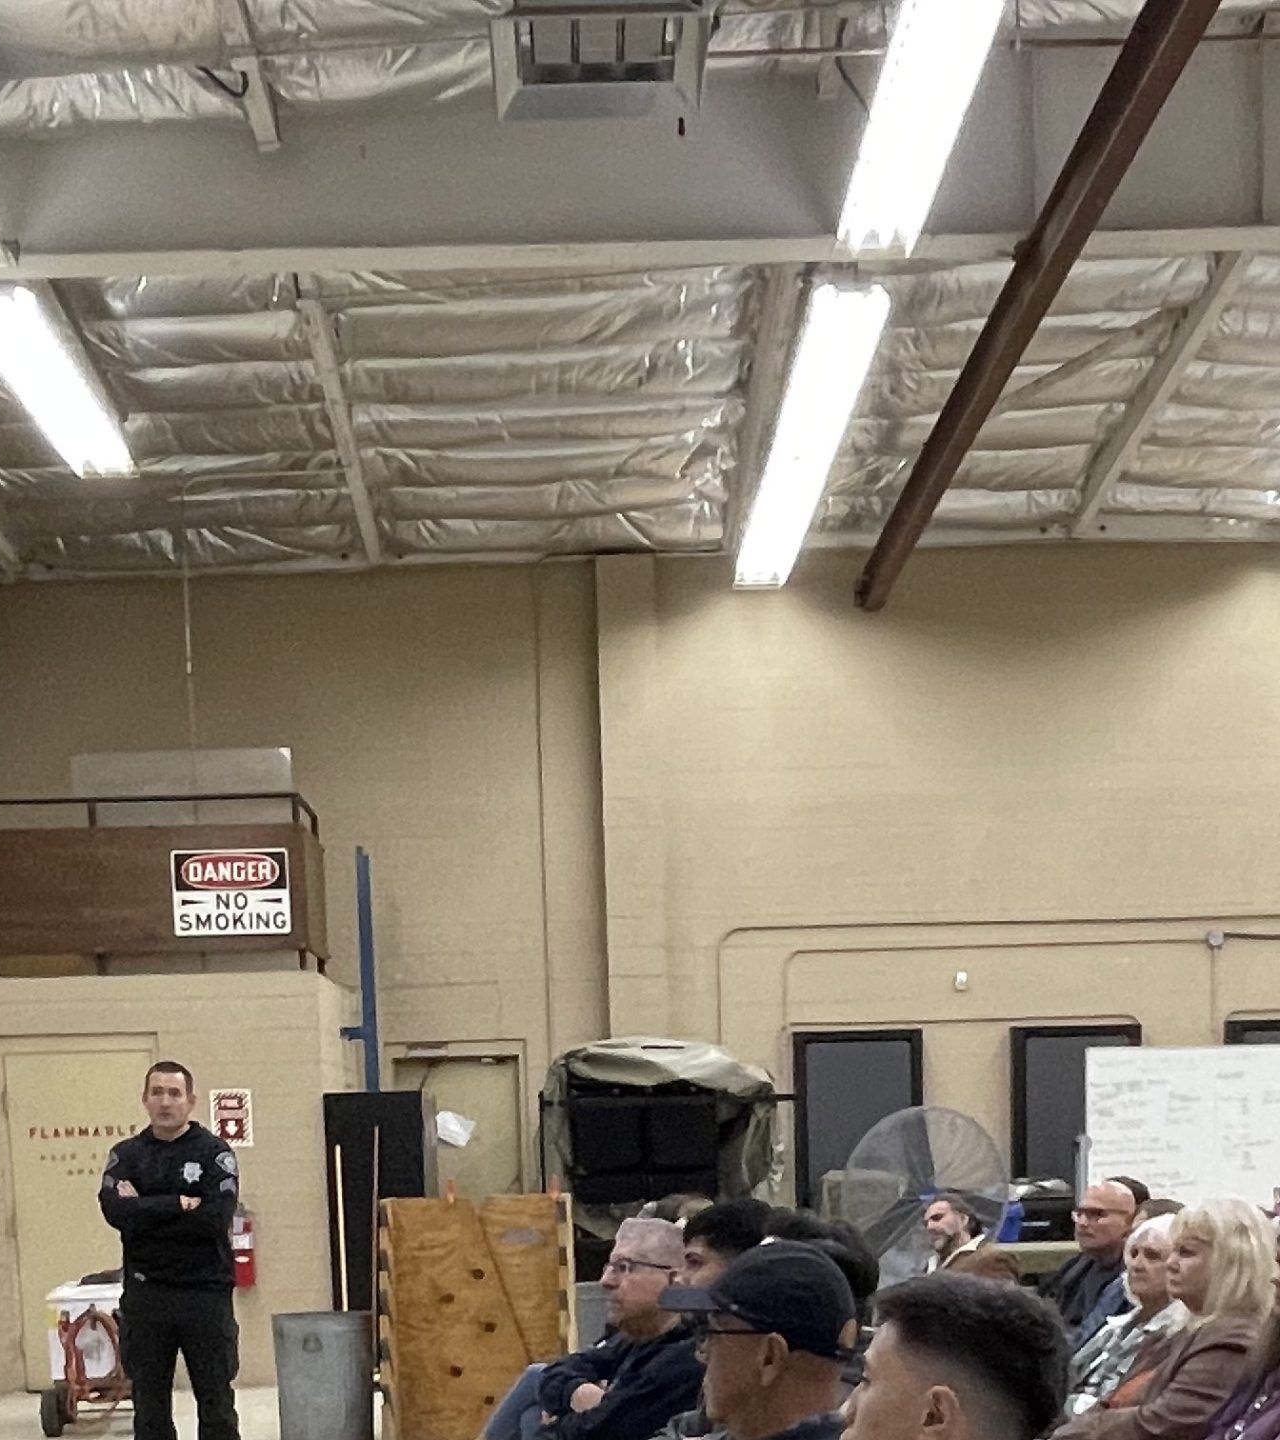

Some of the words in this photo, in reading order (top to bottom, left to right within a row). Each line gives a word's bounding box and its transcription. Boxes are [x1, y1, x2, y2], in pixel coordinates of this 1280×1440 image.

[188, 861, 272, 882] DANGER
[215, 892, 249, 910] NO
[179, 911, 287, 931] SMOKING
